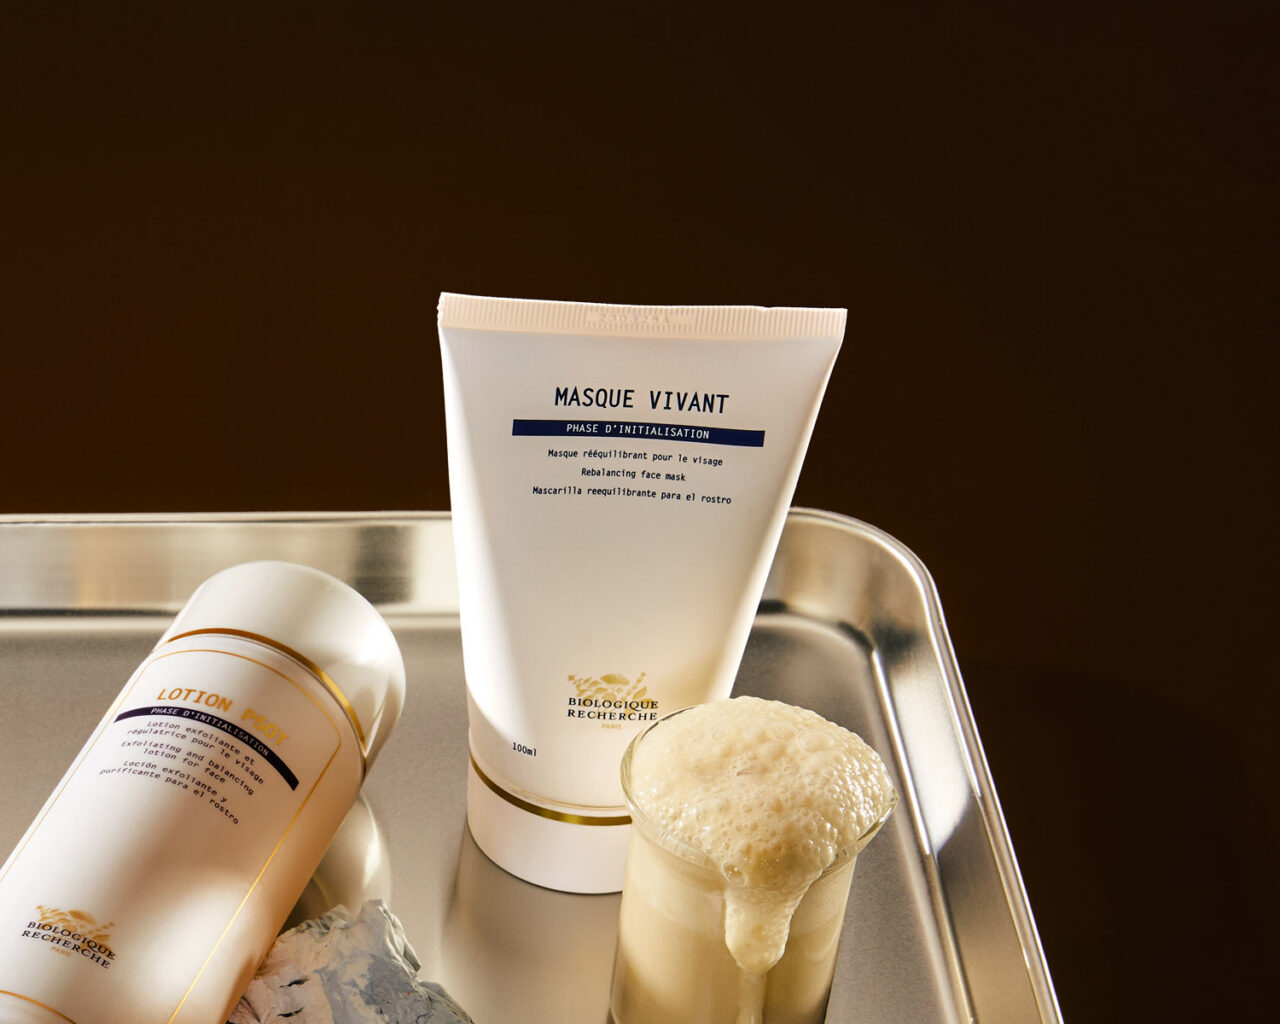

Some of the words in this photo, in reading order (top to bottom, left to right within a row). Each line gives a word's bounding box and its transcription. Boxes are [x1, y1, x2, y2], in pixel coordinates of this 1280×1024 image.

[554, 386, 634, 409] MASQUE
[650, 390, 729, 414] VIVANT
[566, 424, 598, 433] PHASE
[606, 424, 710, 440] D'INITIALISATION
[548, 449, 578, 459] Masque
[583, 450, 647, 460] rééquilibrant
[652, 453, 673, 462] pour
[679, 454, 688, 463] le
[693, 456, 723, 467] visage
[581, 468, 636, 479] Rebalancing
[641, 470, 661, 480] face
[665, 473, 686, 482] mask
[532, 487, 582, 495] Mascarilla
[587, 488, 657, 498] reequilibrante
[661, 492, 681, 501] para
[686, 493, 695, 502] el
[701, 494, 732, 504] rostro
[157, 688, 234, 712] LOTION
[568, 698, 658, 711] BIOLOGIQUE
[568, 709, 658, 721] RECHERCHE
[147, 721, 181, 730] Lotion
[186, 726, 240, 754] exfoliante
[244, 755, 255, 766] et
[150, 707, 178, 716] PHASE
[183, 710, 270, 756] D'INITIALISATION
[127, 728, 187, 740] régulatrice
[191, 737, 215, 750] pour
[220, 749, 231, 759] le
[235, 760, 264, 785] visage
[513, 742, 537, 757] 100ml
[121, 740, 182, 753] Exfoliating
[186, 750, 204, 762] and
[209, 760, 254, 796] balancing
[123, 760, 157, 770] Loción
[162, 767, 218, 796] exfoliante
[144, 749, 177, 760] lotion
[182, 757, 199, 768] for
[204, 767, 226, 783] face
[99, 767, 161, 779] purificante
[165, 776, 188, 790] para
[193, 789, 205, 798] el
[209, 798, 239, 824] rostro
[21, 930, 111, 969] RECHERCHE
[27, 921, 116, 960] BIOLOGIQUE
